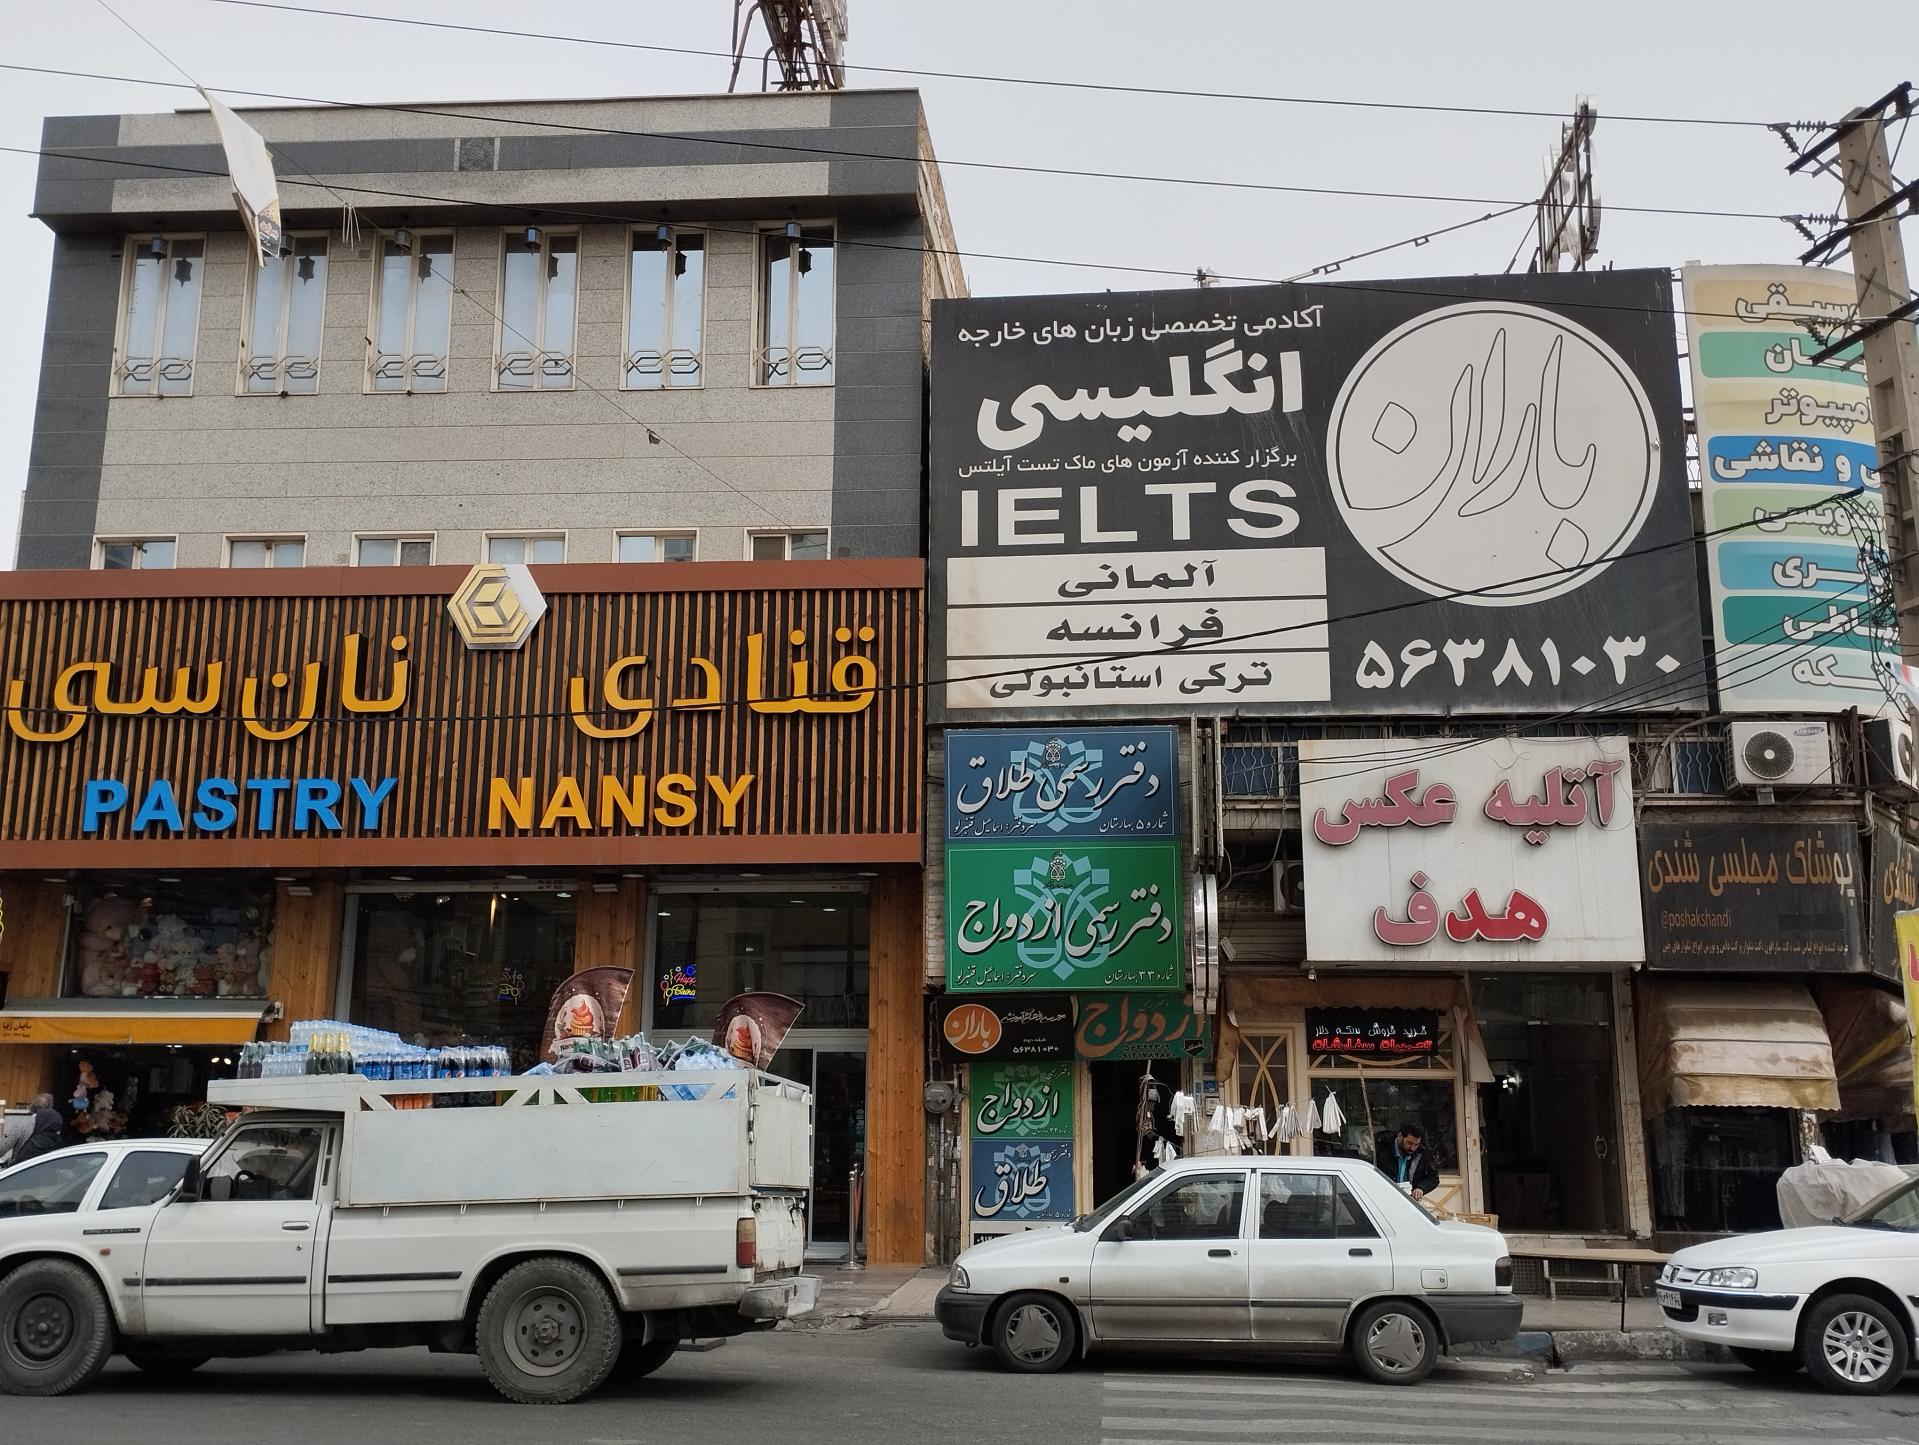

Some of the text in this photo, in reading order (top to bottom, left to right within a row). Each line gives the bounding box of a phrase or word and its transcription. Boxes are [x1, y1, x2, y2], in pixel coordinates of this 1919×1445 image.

[958, 305, 1323, 348] آکادمی تخصصی زبان های خارجه
[977, 338, 1303, 451] انگلیسی
[958, 446, 1297, 479] برگزار کننده آزمون های ماک تست آیلتس
[1349, 328, 1597, 571] باران
[1714, 439, 1824, 480] نقاشی
[961, 479, 1300, 548] IELTS
[1057, 559, 1217, 598] آلمانی
[1046, 608, 1225, 648] فرانسه
[7, 626, 878, 742] قنادی نان سی
[989, 661, 1272, 699] ترکی استانبولی
[1355, 635, 1681, 689] ۵۶۳۸۱۰۳۰
[956, 740, 1160, 813] دفتر رسمی طلاق
[83, 773, 756, 834] PASTRY NANSY
[1099, 810, 1168, 833] شماره ۵ بهارستان
[1313, 760, 1626, 846] آتلیه عکس
[1649, 830, 1857, 907] پوشاک مجلسی شندی
[957, 884, 1173, 957] دفتر رسمی ازدواج
[1373, 871, 1550, 947] هدف
[1660, 908, 1732, 931] @poshakshandi
[1104, 969, 1138, 985] بهارستان
[1138, 970, 1155, 981] ۳۳
[947, 1008, 991, 1049] باران
[1012, 1045, 1059, 1054] ۵۶۳۸۱۰۳۰
[1315, 1022, 1428, 1038] خرید فروش سکه دلار
[977, 1081, 1059, 1133] ازدواج
[975, 1160, 1048, 1217] طلاق
